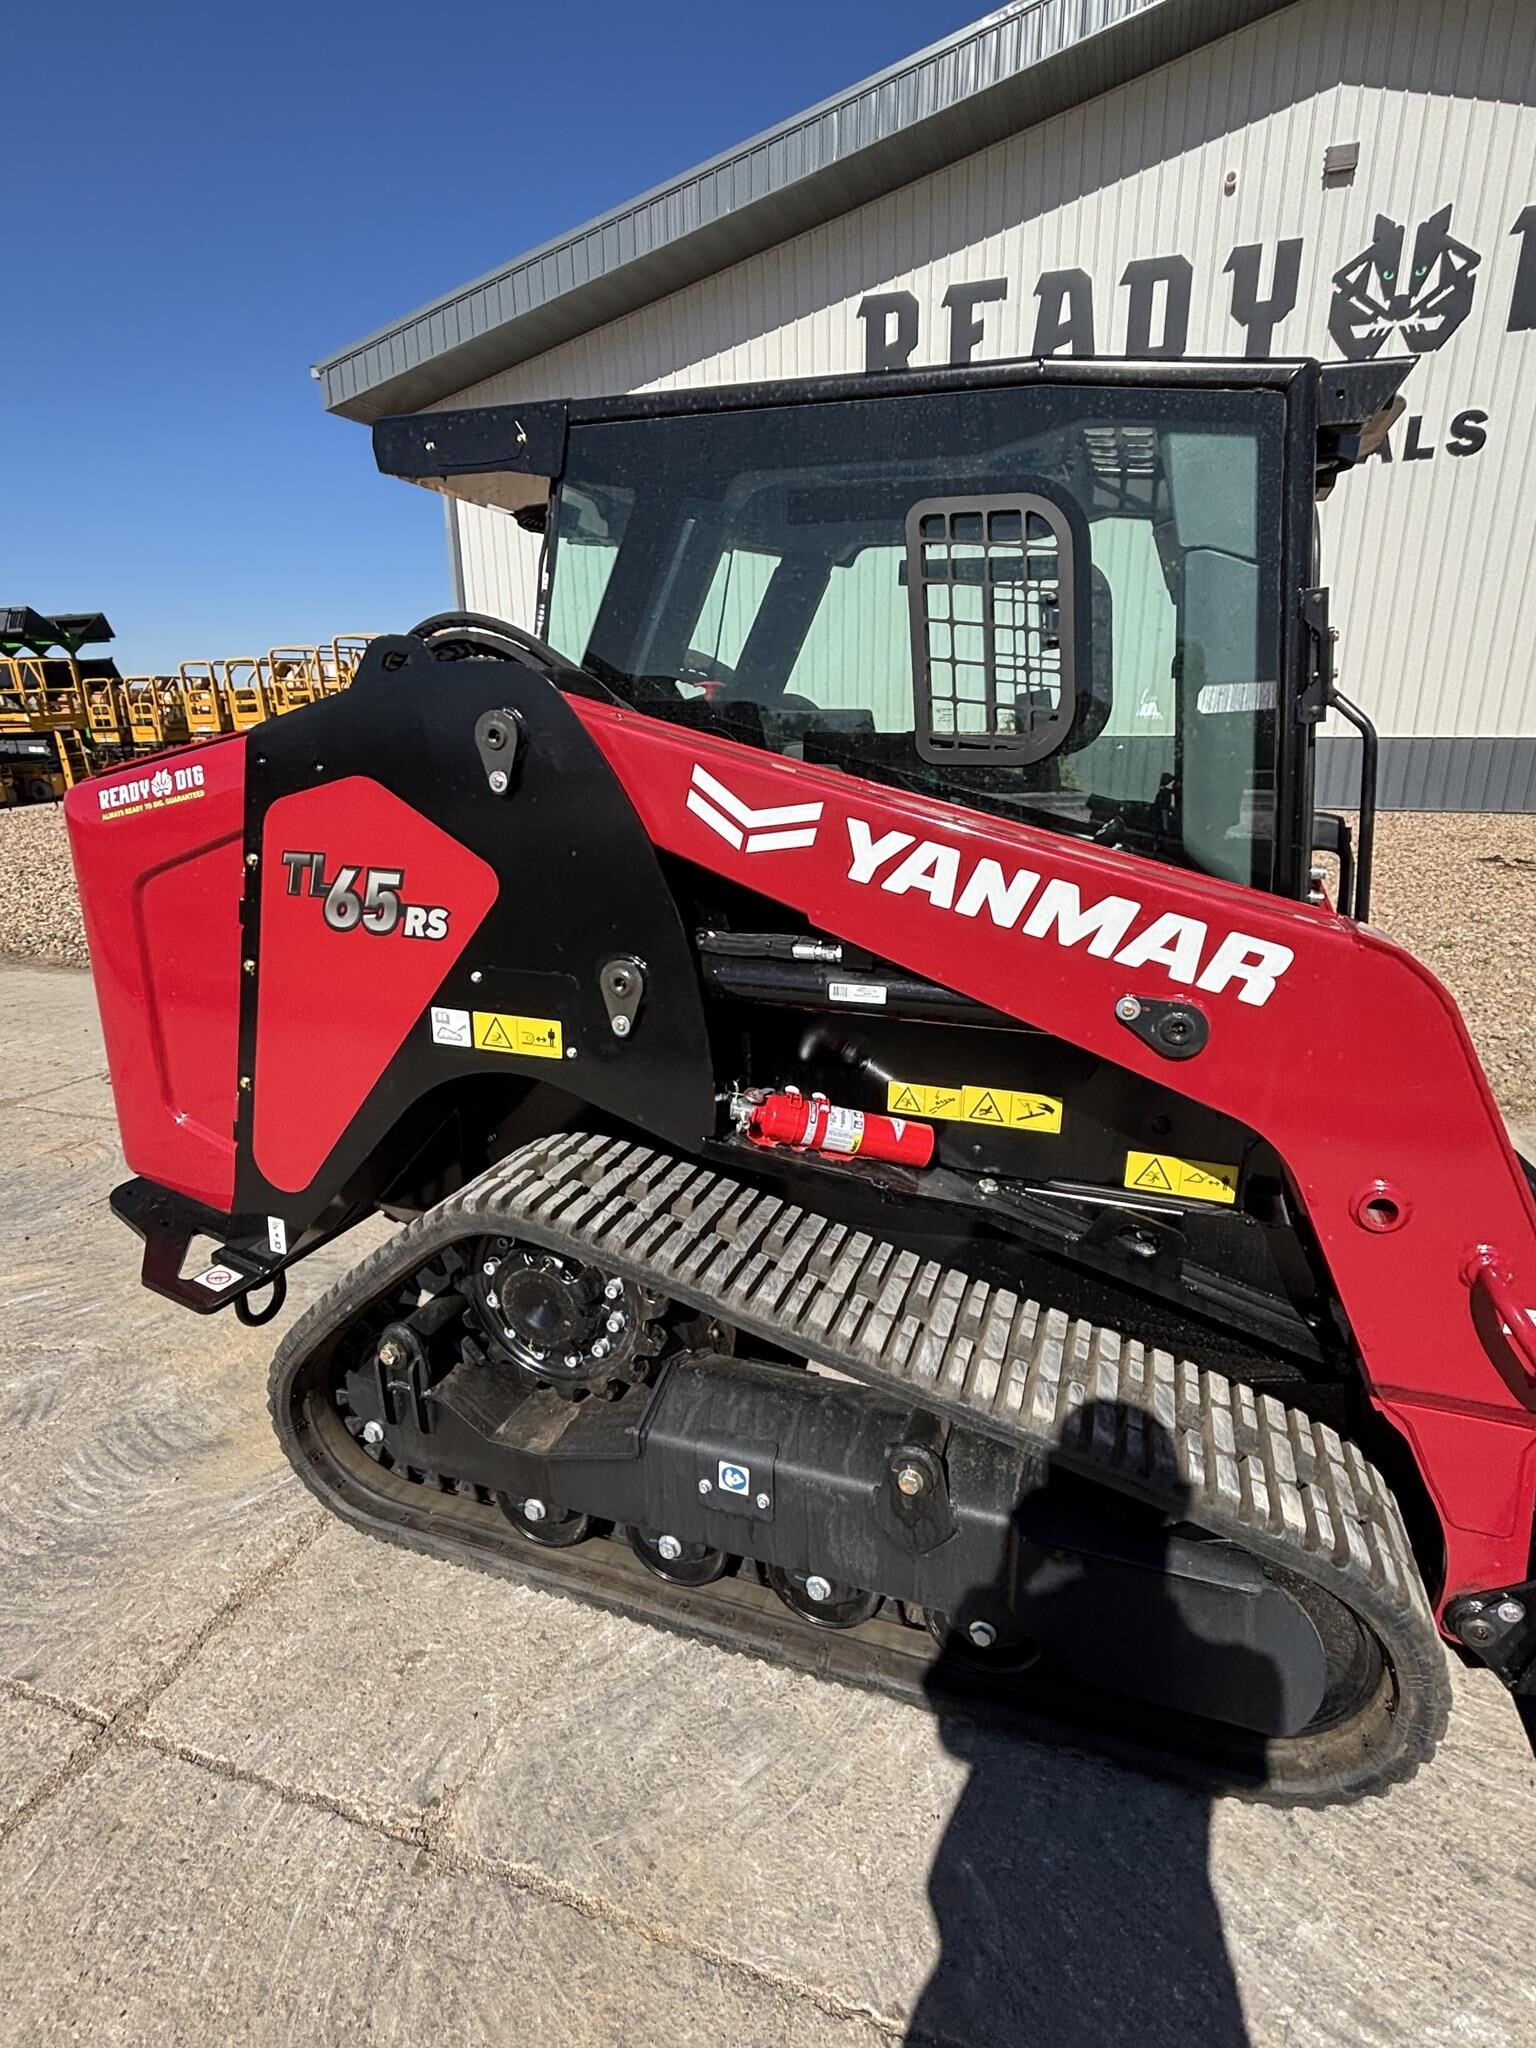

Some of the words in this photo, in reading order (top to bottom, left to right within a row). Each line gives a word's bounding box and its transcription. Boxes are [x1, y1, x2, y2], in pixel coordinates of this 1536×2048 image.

[856, 237, 1304, 373] READY
[98, 778, 149, 810] READY
[174, 764, 205, 791] DIG
[102, 809, 125, 821] ALWAYS
[125, 804, 144, 815] READY
[144, 802, 153, 810] TO
[165, 789, 205, 805] GUARANTEED
[845, 816, 1295, 1008] YANMAR
